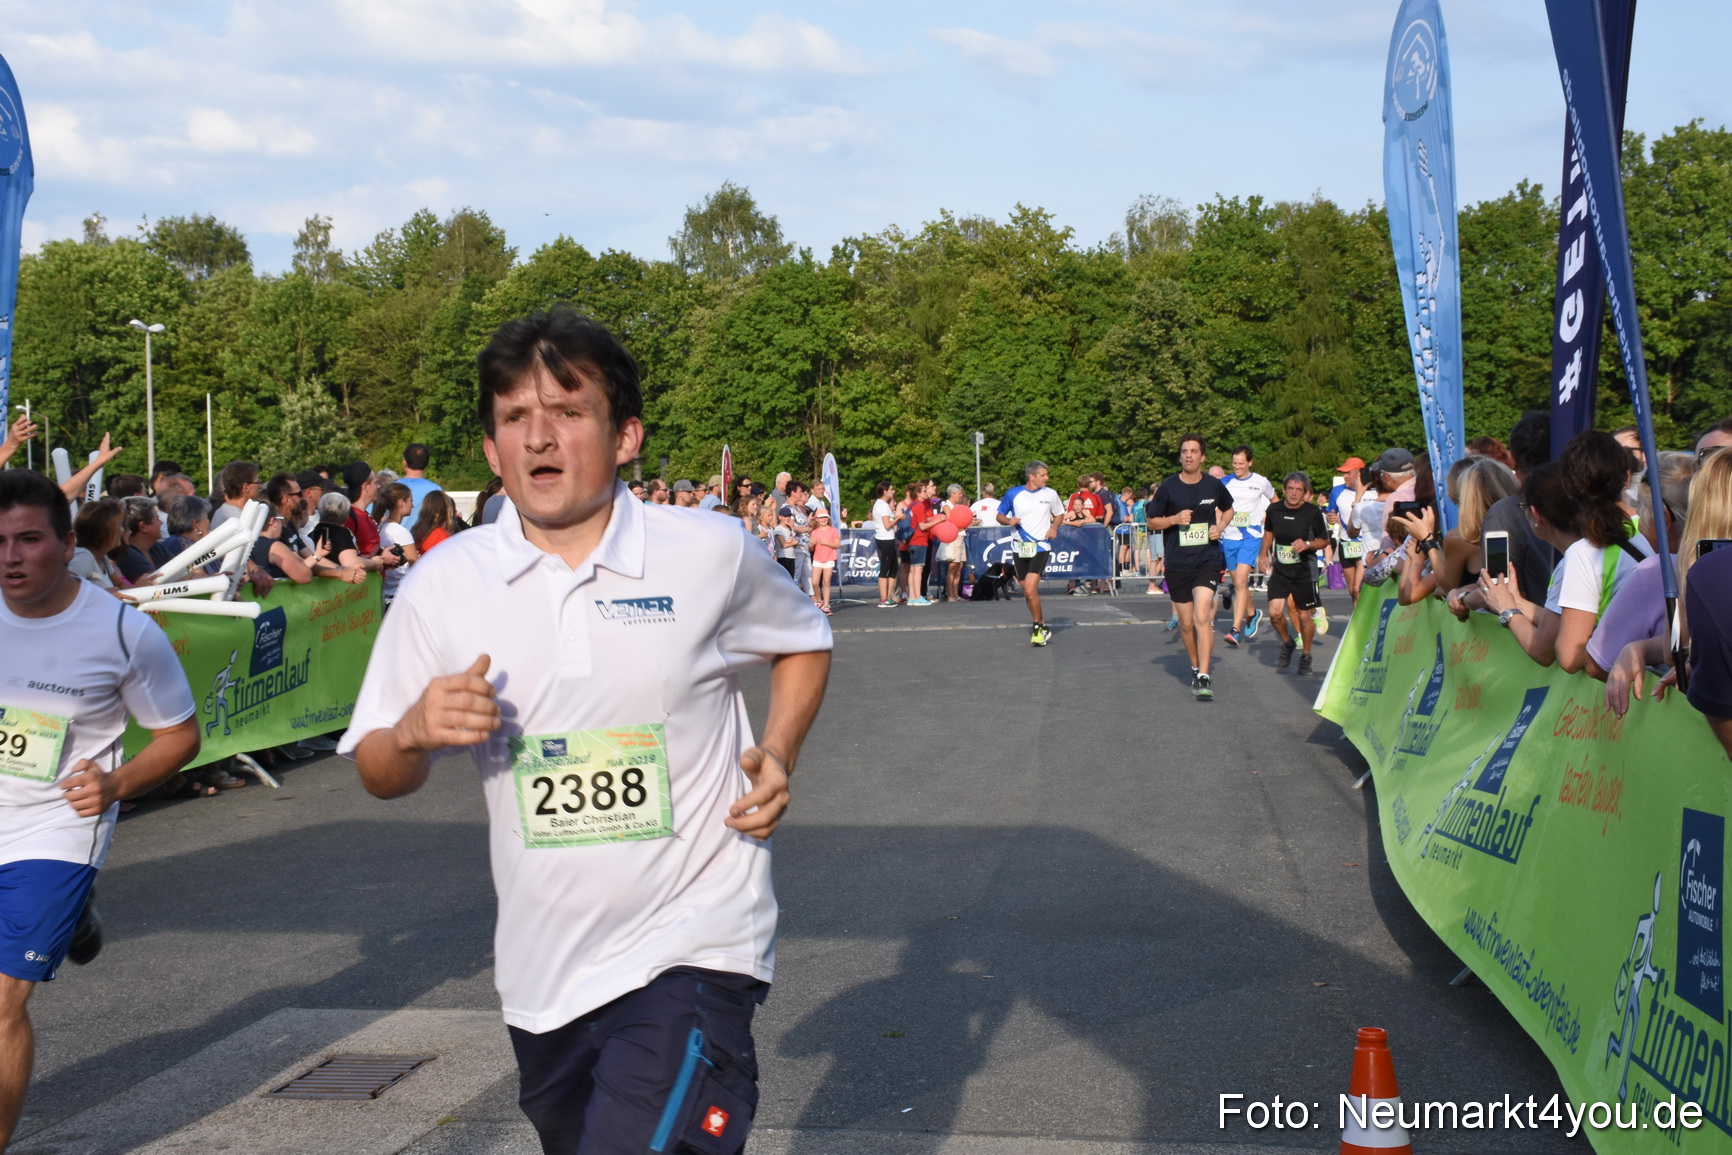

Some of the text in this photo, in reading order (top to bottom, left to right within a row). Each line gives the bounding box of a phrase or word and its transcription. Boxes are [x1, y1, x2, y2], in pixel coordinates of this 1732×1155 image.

[1184, 531, 1205, 540] 1402
[841, 552, 879, 568] Fisc
[845, 570, 880, 578] AUTOM
[594, 596, 676, 619] VETTER
[260, 628, 283, 643] Fischer
[27, 680, 86, 697] auctores
[234, 648, 311, 713] firmenlauf
[235, 704, 270, 729] neumarkt
[532, 768, 647, 815] 2388
[583, 811, 636, 826] Christian
[1686, 869, 1717, 911] Fischer
[1688, 909, 1714, 932] AUTOMOBILE
